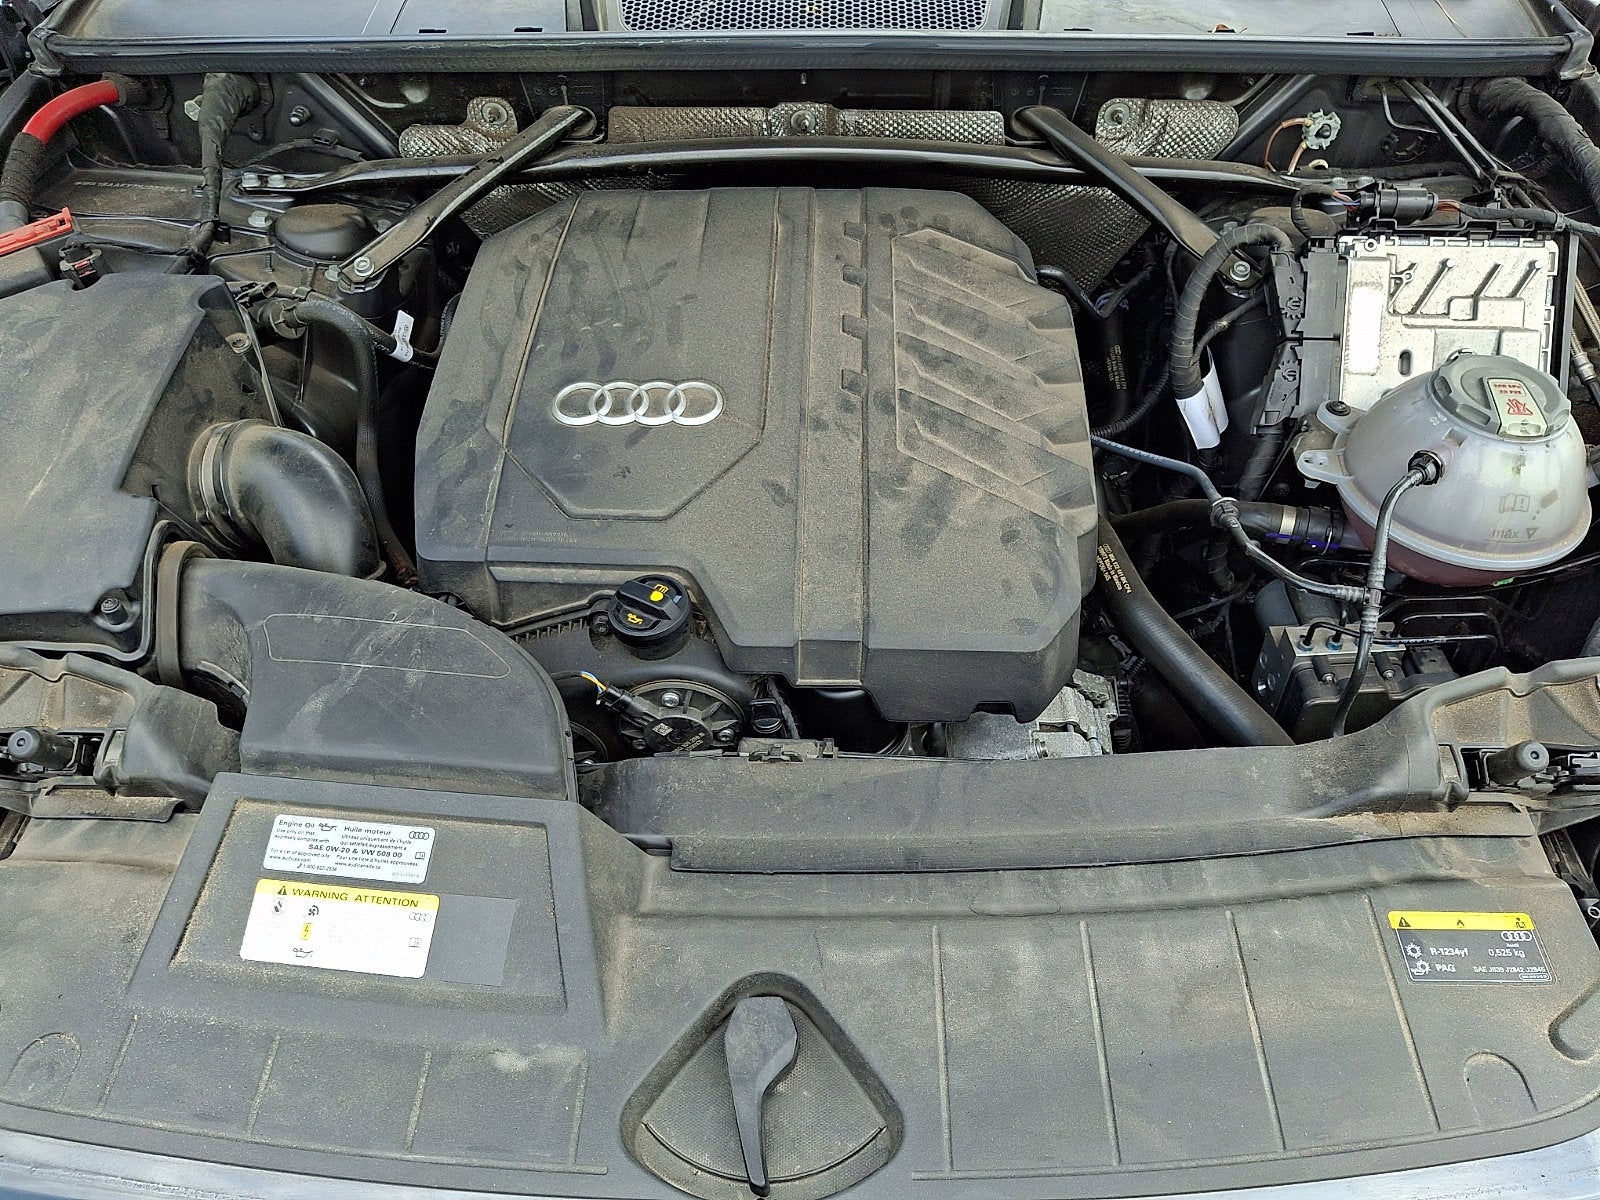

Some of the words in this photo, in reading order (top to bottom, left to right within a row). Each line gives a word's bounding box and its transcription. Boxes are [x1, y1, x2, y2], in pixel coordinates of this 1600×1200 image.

[292, 888, 348, 901] WARNING
[354, 894, 419, 908] ATTENTION
[1430, 947, 1468, 958] R-1234yf
[1488, 948, 1512, 957] 0,525
[1513, 948, 1526, 958] kg
[1435, 963, 1456, 973] PAG
